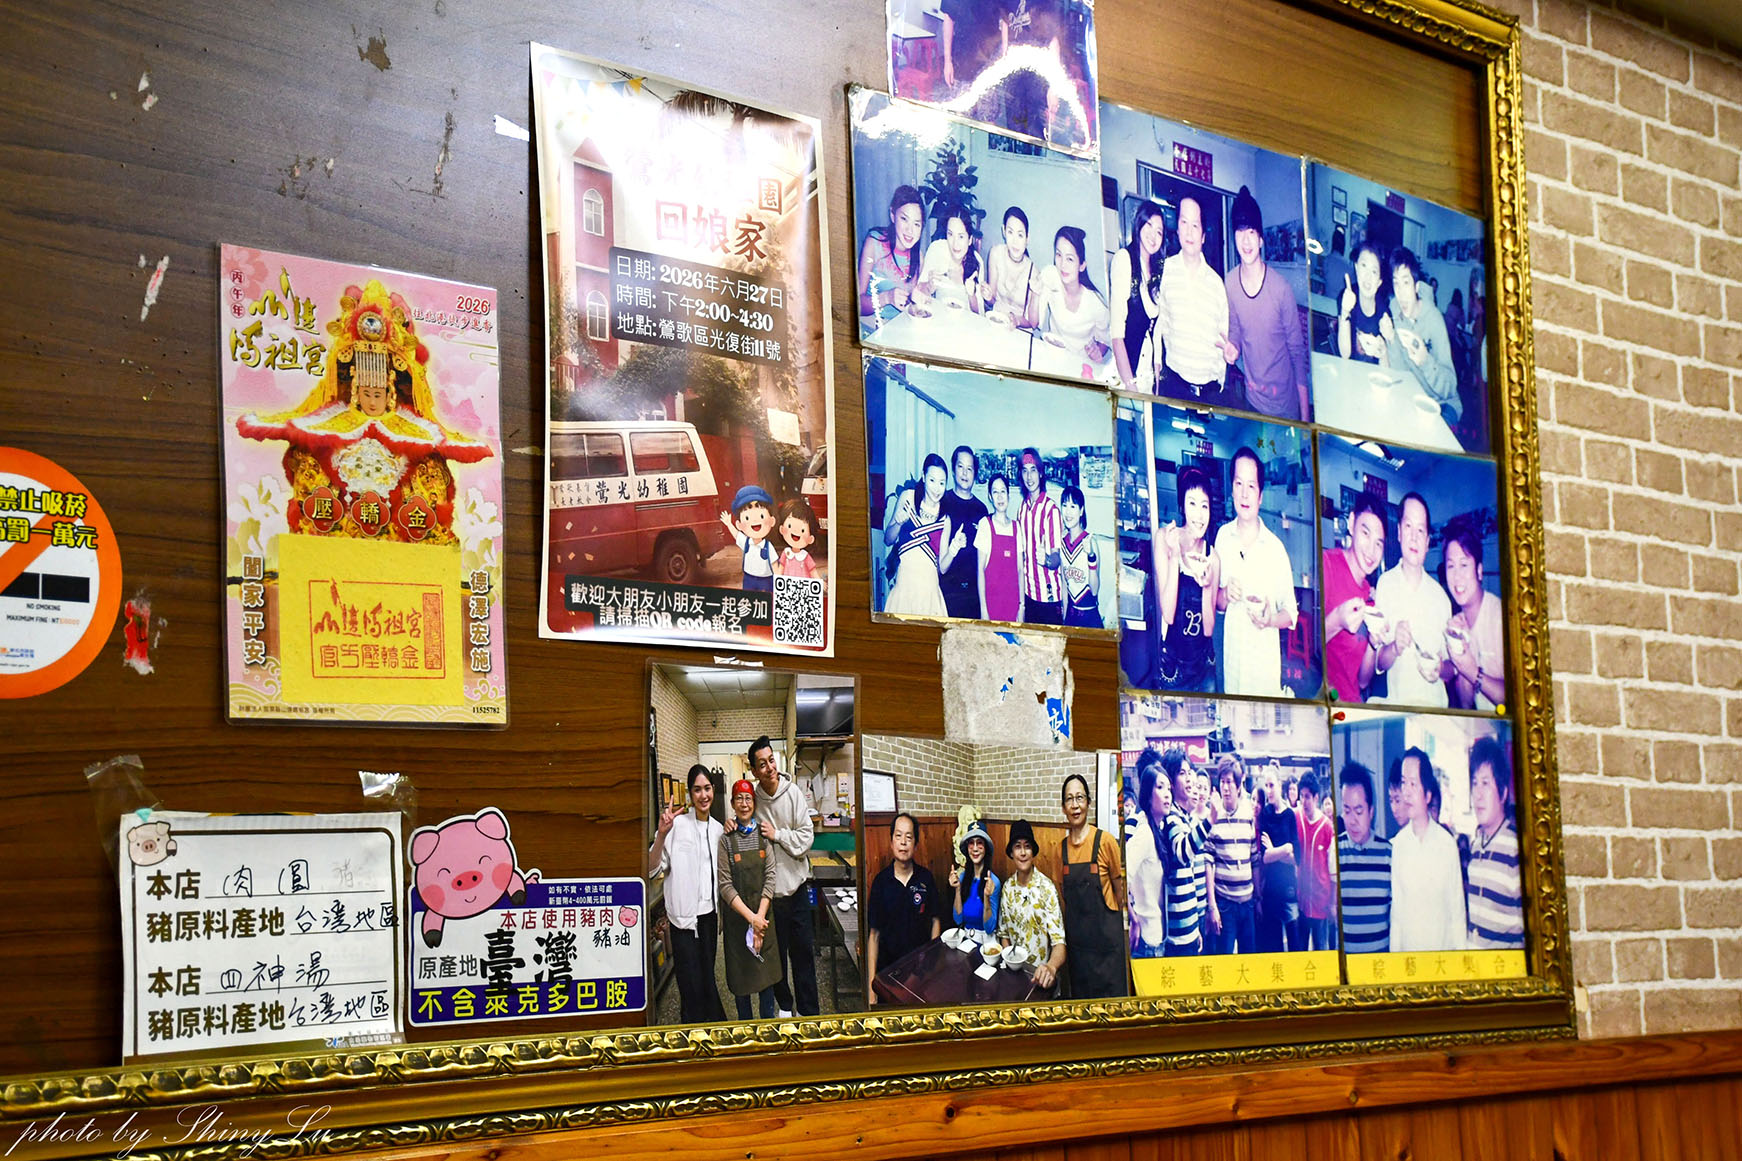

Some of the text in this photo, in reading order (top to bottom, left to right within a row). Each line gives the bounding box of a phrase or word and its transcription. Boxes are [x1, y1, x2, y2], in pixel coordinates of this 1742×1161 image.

[655, 200, 768, 263] 回娘家
[231, 271, 244, 317] 丙午年
[457, 296, 489, 314] 2026
[0, 485, 87, 518] 禁止吸菸
[312, 497, 427, 528] 壓轎金
[571, 583, 768, 620] 歡迎大朋友小朋友一起參加
[469, 570, 490, 671] 德澤宏施
[1183, 610, 1202, 636] B
[146, 869, 201, 900] 本店
[146, 906, 285, 943] 豬原料產地
[500, 907, 614, 930] 本店使用豬肉
[592, 928, 631, 949] 豬油
[221, 951, 330, 993] 四神湯
[419, 954, 478, 980] 原產地
[480, 929, 578, 995] 臺灣
[1161, 960, 1316, 988] 綜藝大集合
[1372, 955, 1506, 979] 綜藝大集合
[148, 964, 201, 998] 本店
[418, 979, 628, 1020] 不含萊克多巴胺
[148, 1000, 285, 1041] 豬原料產地
